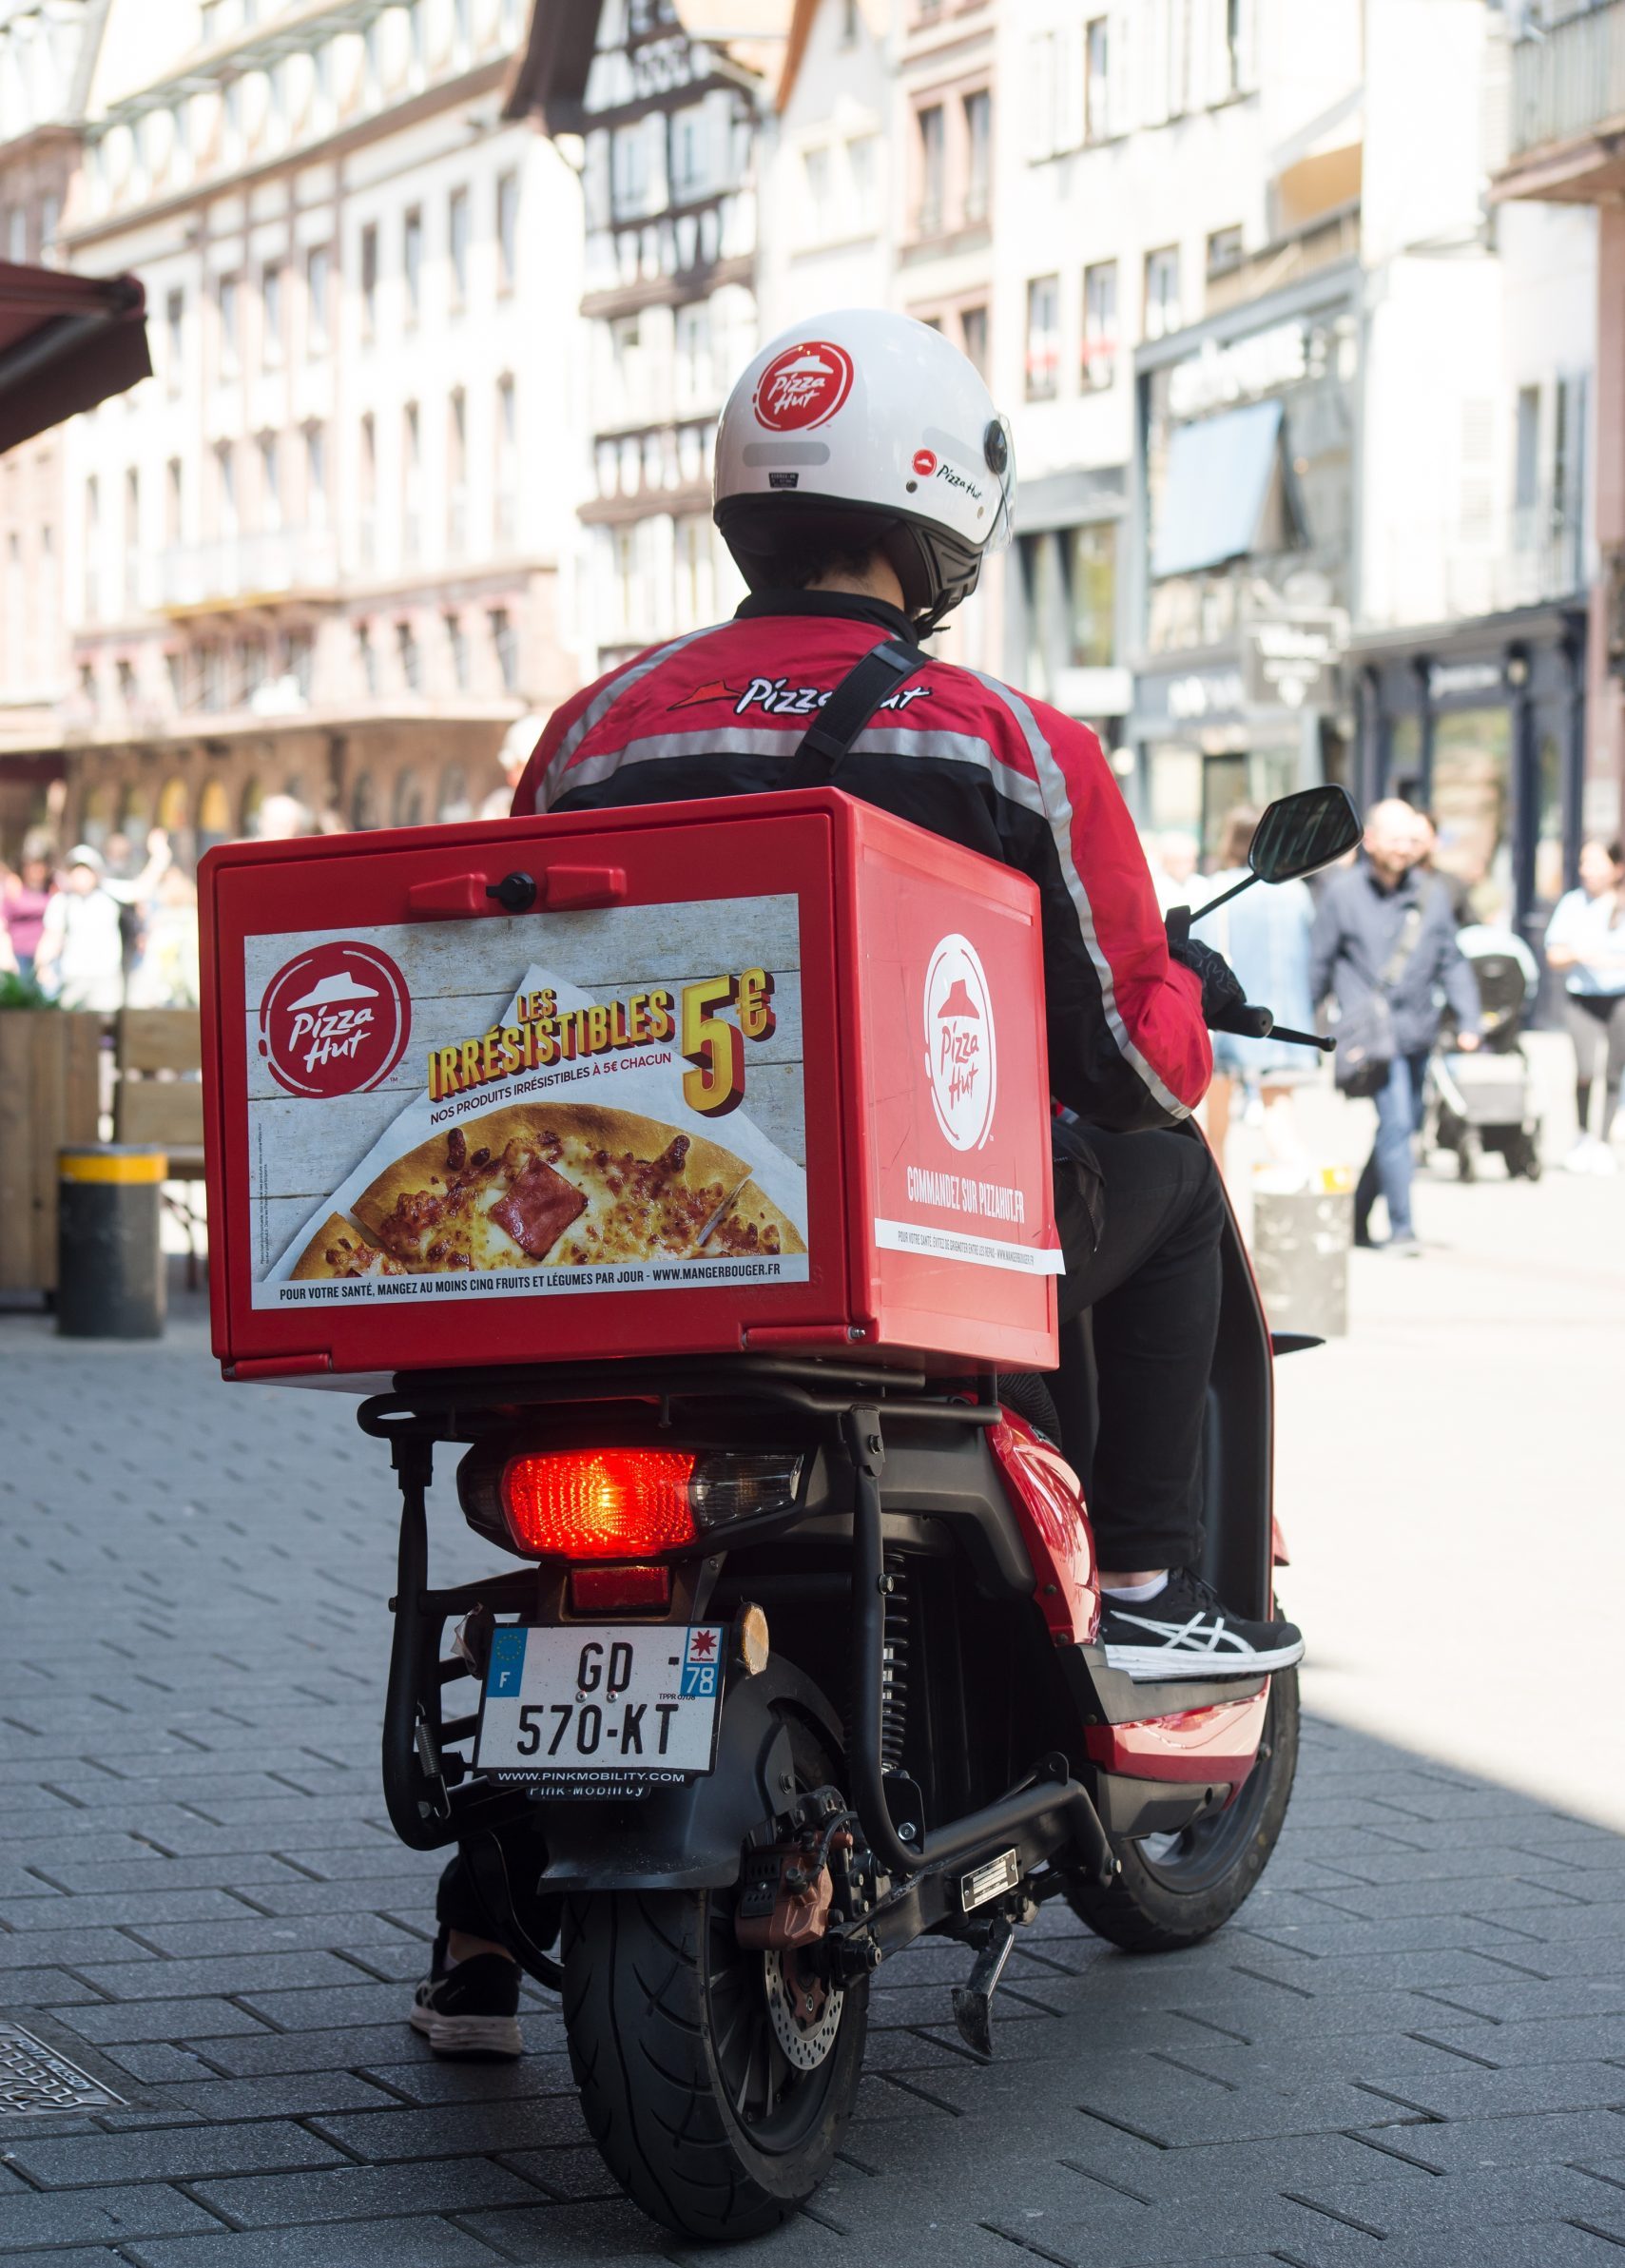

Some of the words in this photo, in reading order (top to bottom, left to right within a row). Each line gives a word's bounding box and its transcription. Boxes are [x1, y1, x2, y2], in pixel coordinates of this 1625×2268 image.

[767, 374, 825, 400] Pizza
[774, 391, 820, 416] Hut
[937, 465, 965, 488] Pizza
[966, 480, 983, 501] Hut
[517, 987, 557, 1024] LES
[289, 1005, 375, 1052] Pizza
[428, 989, 676, 1103] IRRÉSISTIBLES
[940, 1020, 979, 1076] Pizza
[303, 1030, 372, 1073] Hut
[430, 1106, 455, 1125] NOS
[456, 1086, 512, 1116] PRODUITS
[513, 1066, 590, 1095] IRRÉSISTIBLES
[592, 1062, 601, 1076] À
[603, 1061, 618, 1075] 5€
[620, 1052, 672, 1071] CHACUN
[948, 1062, 979, 1111] Hut
[907, 1165, 960, 1211] COMMANDEZ
[961, 1177, 978, 1215] SUR
[978, 1181, 1025, 1224] PIZZAHUT.FR
[279, 1287, 306, 1301] POUR
[309, 1286, 339, 1300] VOTRE
[341, 1282, 376, 1298] SANTÉ,
[377, 1282, 417, 1296] MANGEZ
[420, 1281, 433, 1293] AU
[435, 1279, 468, 1292] MOINS
[470, 1277, 493, 1291] CINQ
[495, 1275, 531, 1289] FRUITS
[532, 1274, 545, 1288] ET
[547, 1271, 593, 1287] LÉGUMES
[595, 1271, 615, 1284] PAR
[617, 1270, 644, 1284] JOUR
[652, 1263, 781, 1282] WWW.MANGERBOUGER.FR
[498, 1671, 511, 1688] F
[577, 1641, 633, 1693] GD
[687, 1667, 715, 1694] 78
[516, 1703, 680, 1755] 570-KT
[497, 1772, 686, 1783] WWW.PINKMOBILITY.COM
